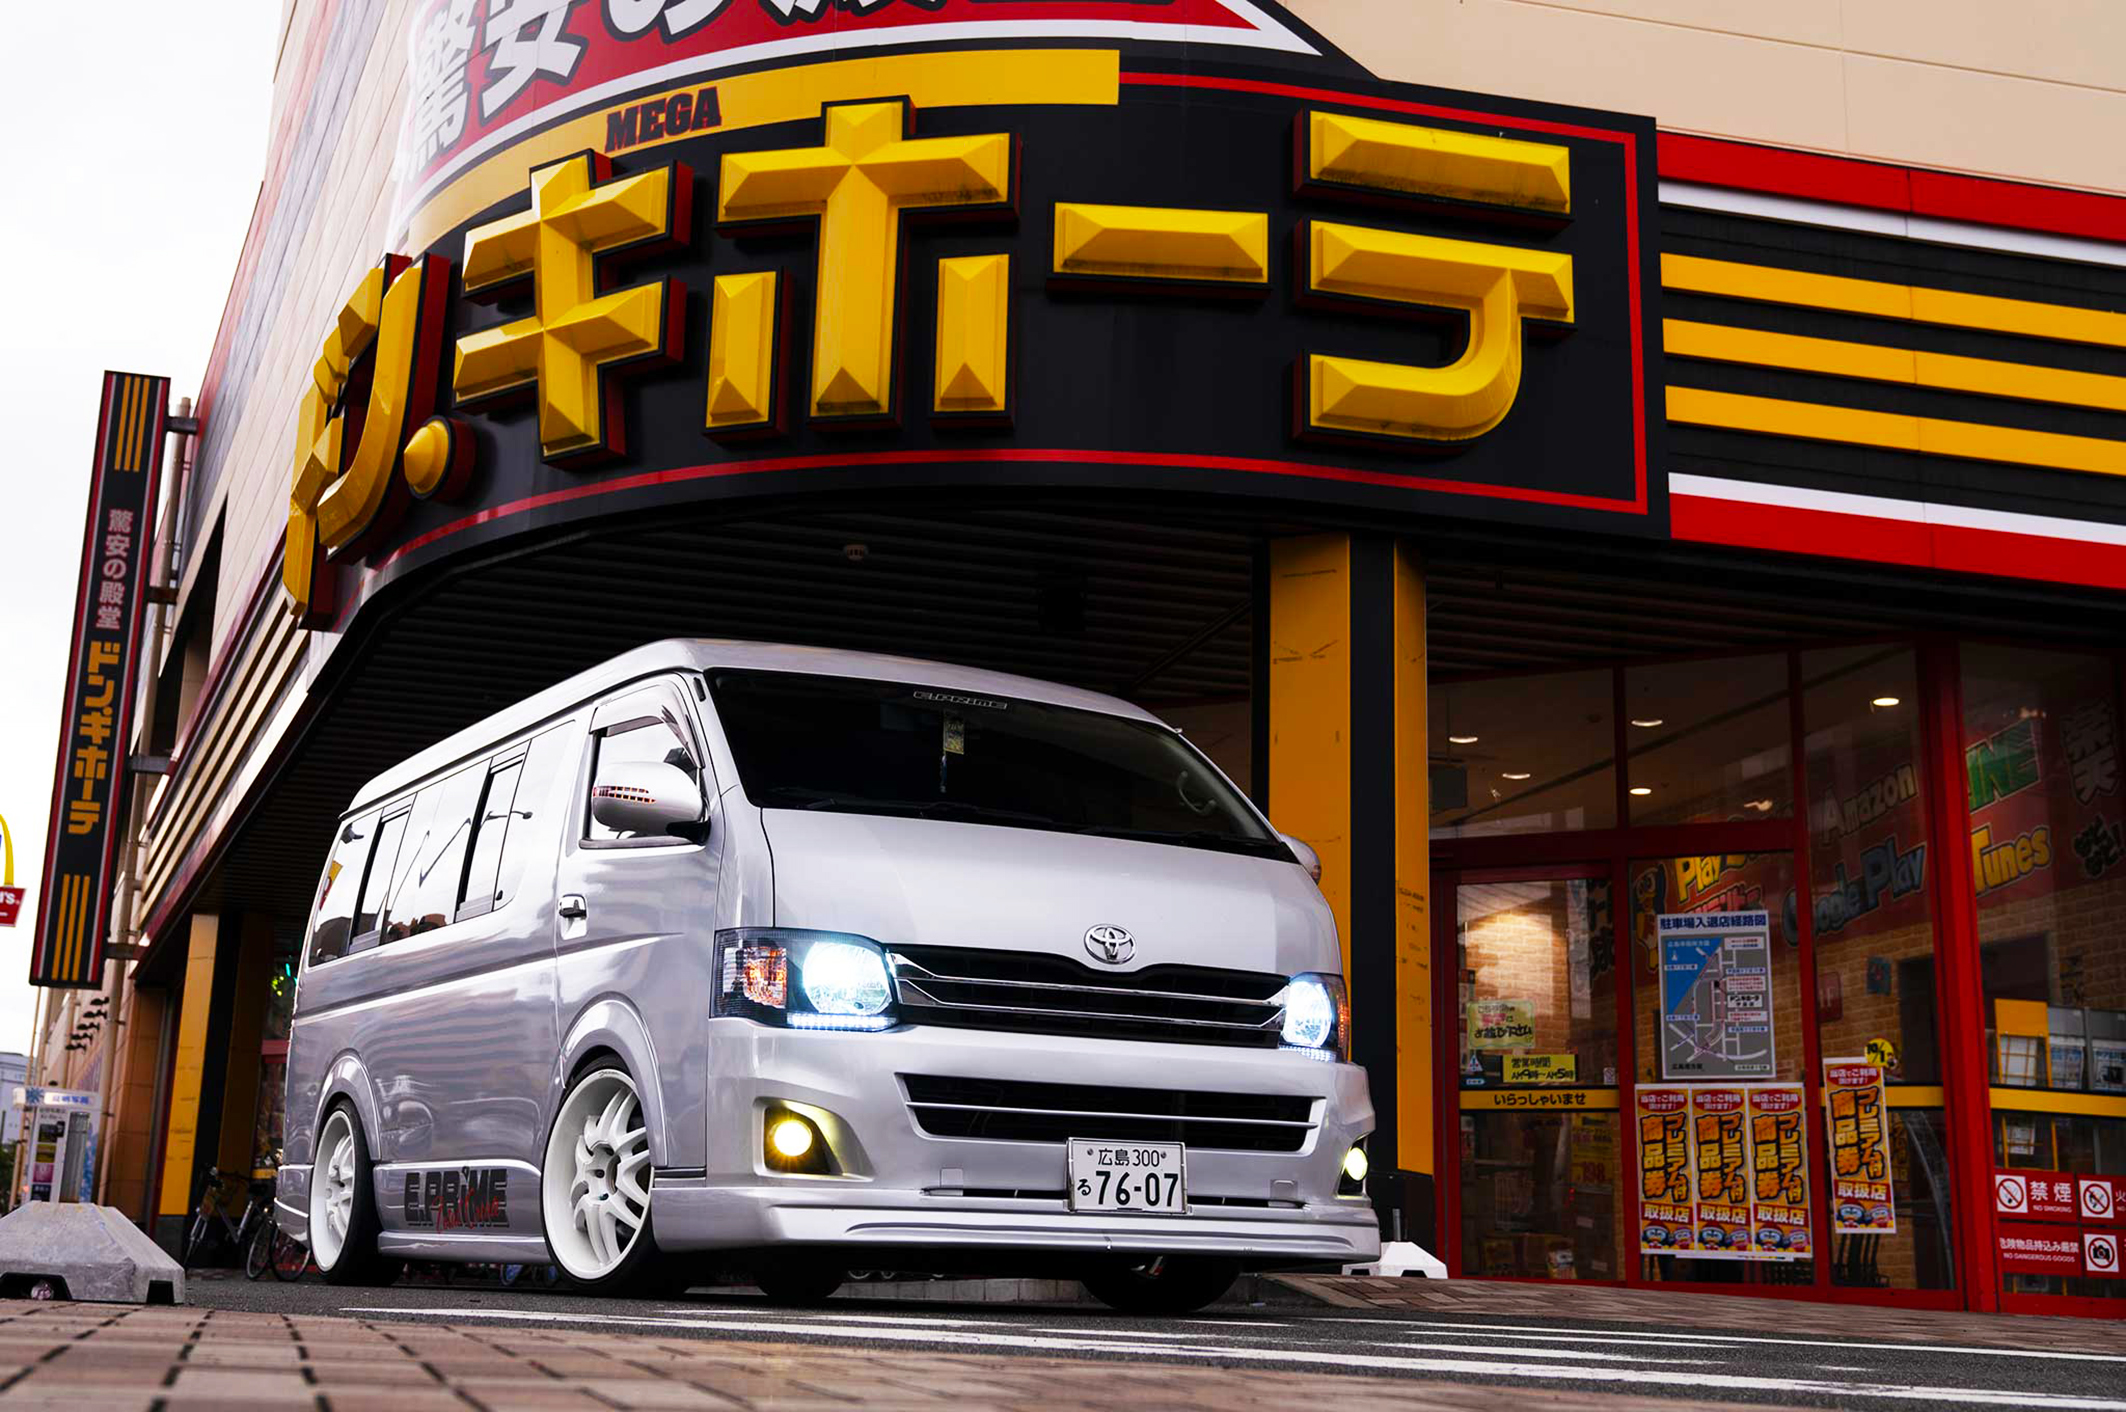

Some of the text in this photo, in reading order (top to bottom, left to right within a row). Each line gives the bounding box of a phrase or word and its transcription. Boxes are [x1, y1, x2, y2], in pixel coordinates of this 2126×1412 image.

[605, 86, 722, 153] MEGA
[96, 508, 134, 630] 驚安の殿堂
[1966, 717, 2041, 814] INE
[1821, 763, 1918, 847] Amazon
[1860, 835, 1927, 909] Play
[1970, 823, 2050, 898] Tunes
[1660, 914, 1767, 930] 駐車場入退店経路図
[1494, 1093, 1586, 1106] いらっしゃいませ
[1829, 1089, 1861, 1178] 商品券
[1856, 1086, 1885, 1180] プレミアム付
[1096, 1170, 1178, 1207] 76-07
[1640, 1114, 1667, 1199] 商品券
[1664, 1112, 1689, 1203] プレミアム付
[1695, 1114, 1723, 1200] 商品券
[1721, 1112, 1746, 1204] プレミアム付
[1752, 1114, 1780, 1201] 商品券
[1778, 1112, 1803, 1205] プレミアム付
[1837, 1183, 1887, 1200] 取扱店
[2030, 1181, 2072, 1202] 禁煙
[1644, 1205, 1690, 1223] 取扱店
[1700, 1205, 1747, 1224] 取扱店
[1757, 1205, 1806, 1225] 取扱店
[2014, 1253, 2051, 1261] DANGEROUS
